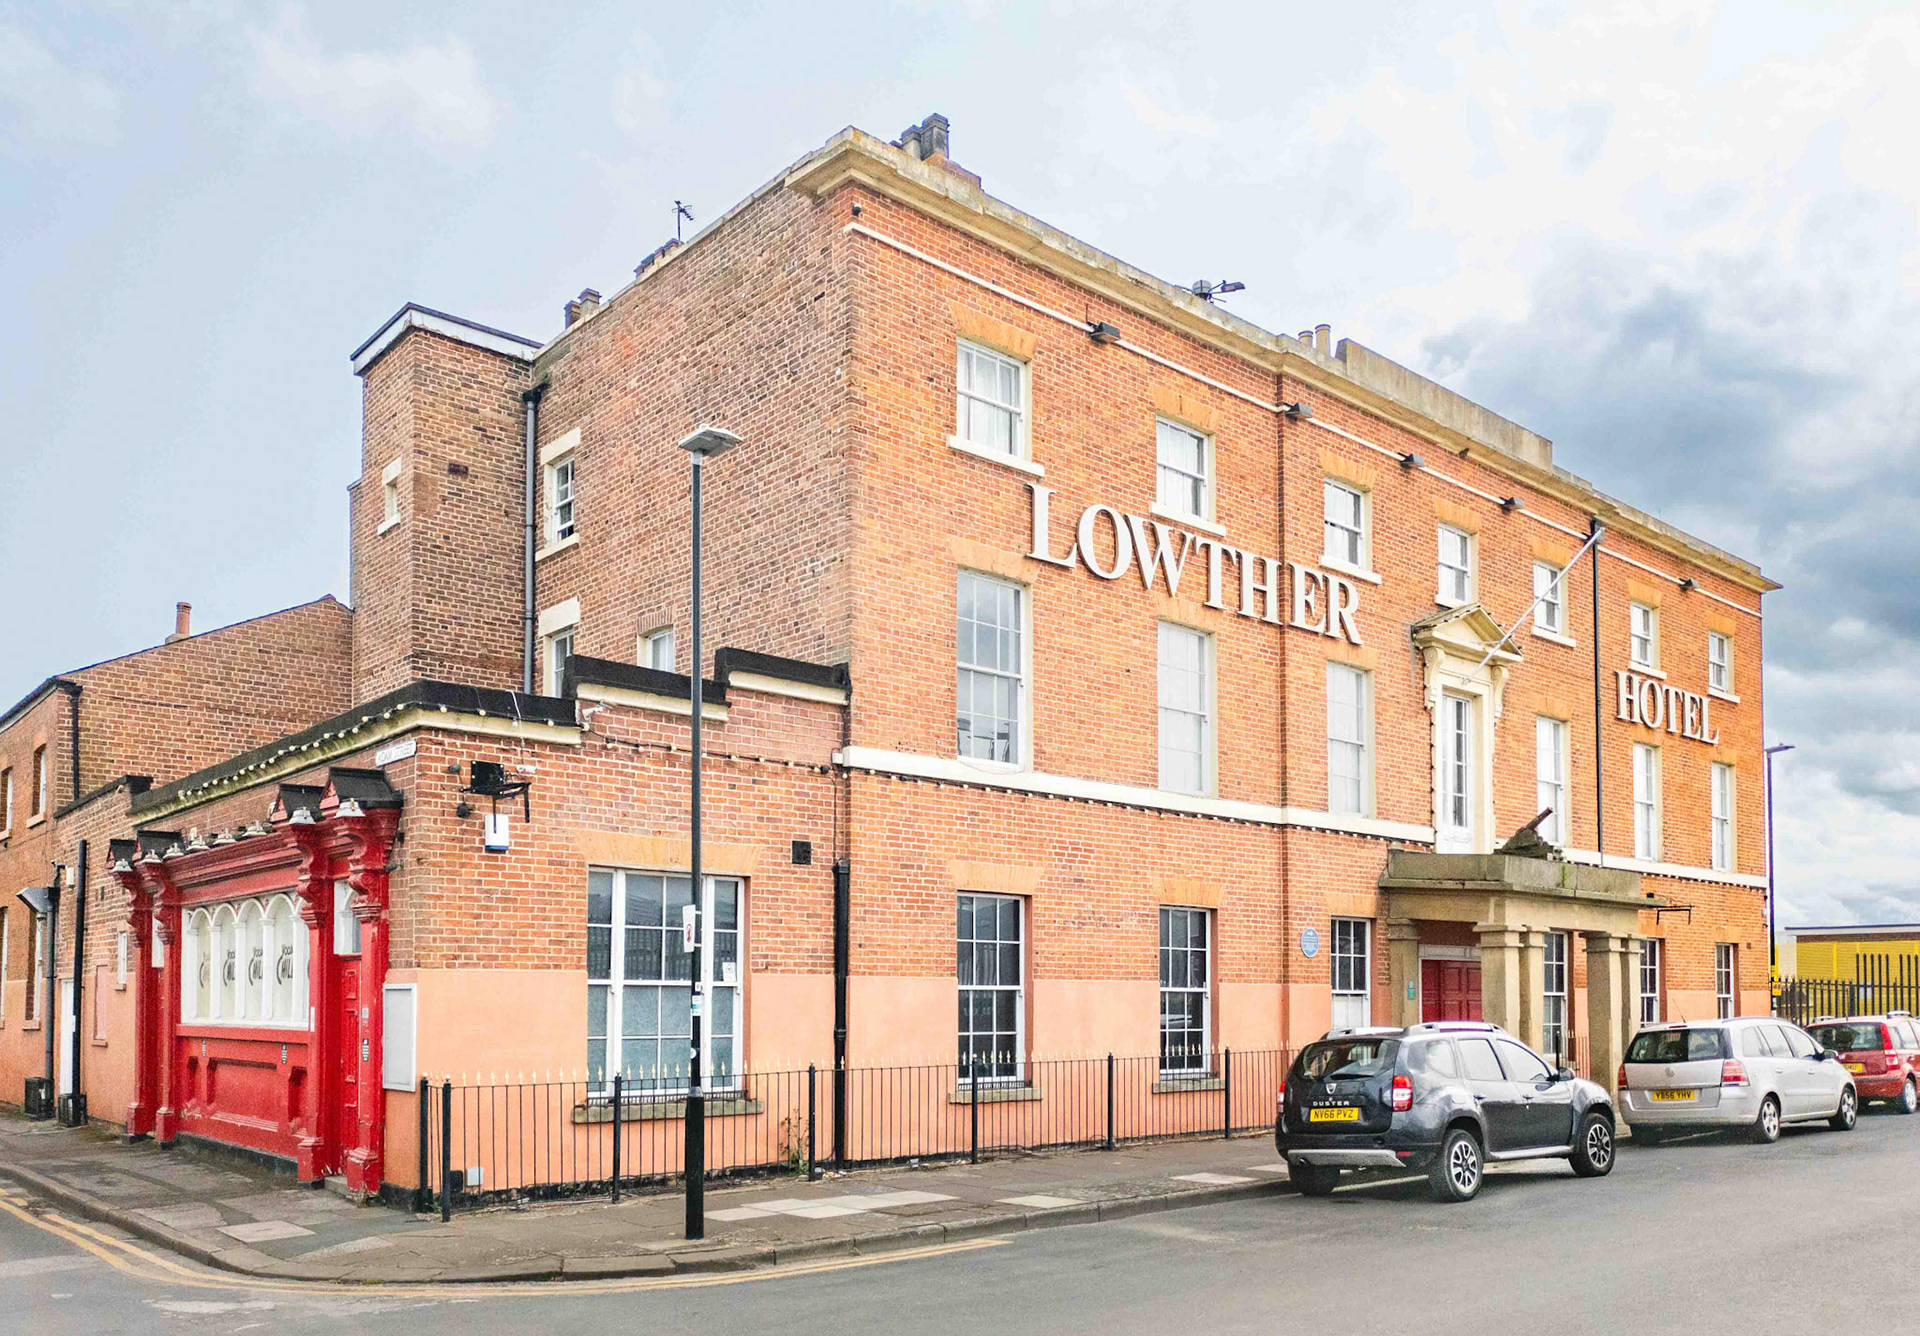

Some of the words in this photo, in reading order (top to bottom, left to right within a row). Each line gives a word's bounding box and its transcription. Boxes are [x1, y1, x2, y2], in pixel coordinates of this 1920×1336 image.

[1025, 482, 1363, 646] LOWTHER
[1614, 671, 1720, 745] HOTEL
[1313, 1109, 1335, 1119] NV66
[1336, 1109, 1354, 1119] PVZ
[1677, 1090, 1692, 1099] YHV
